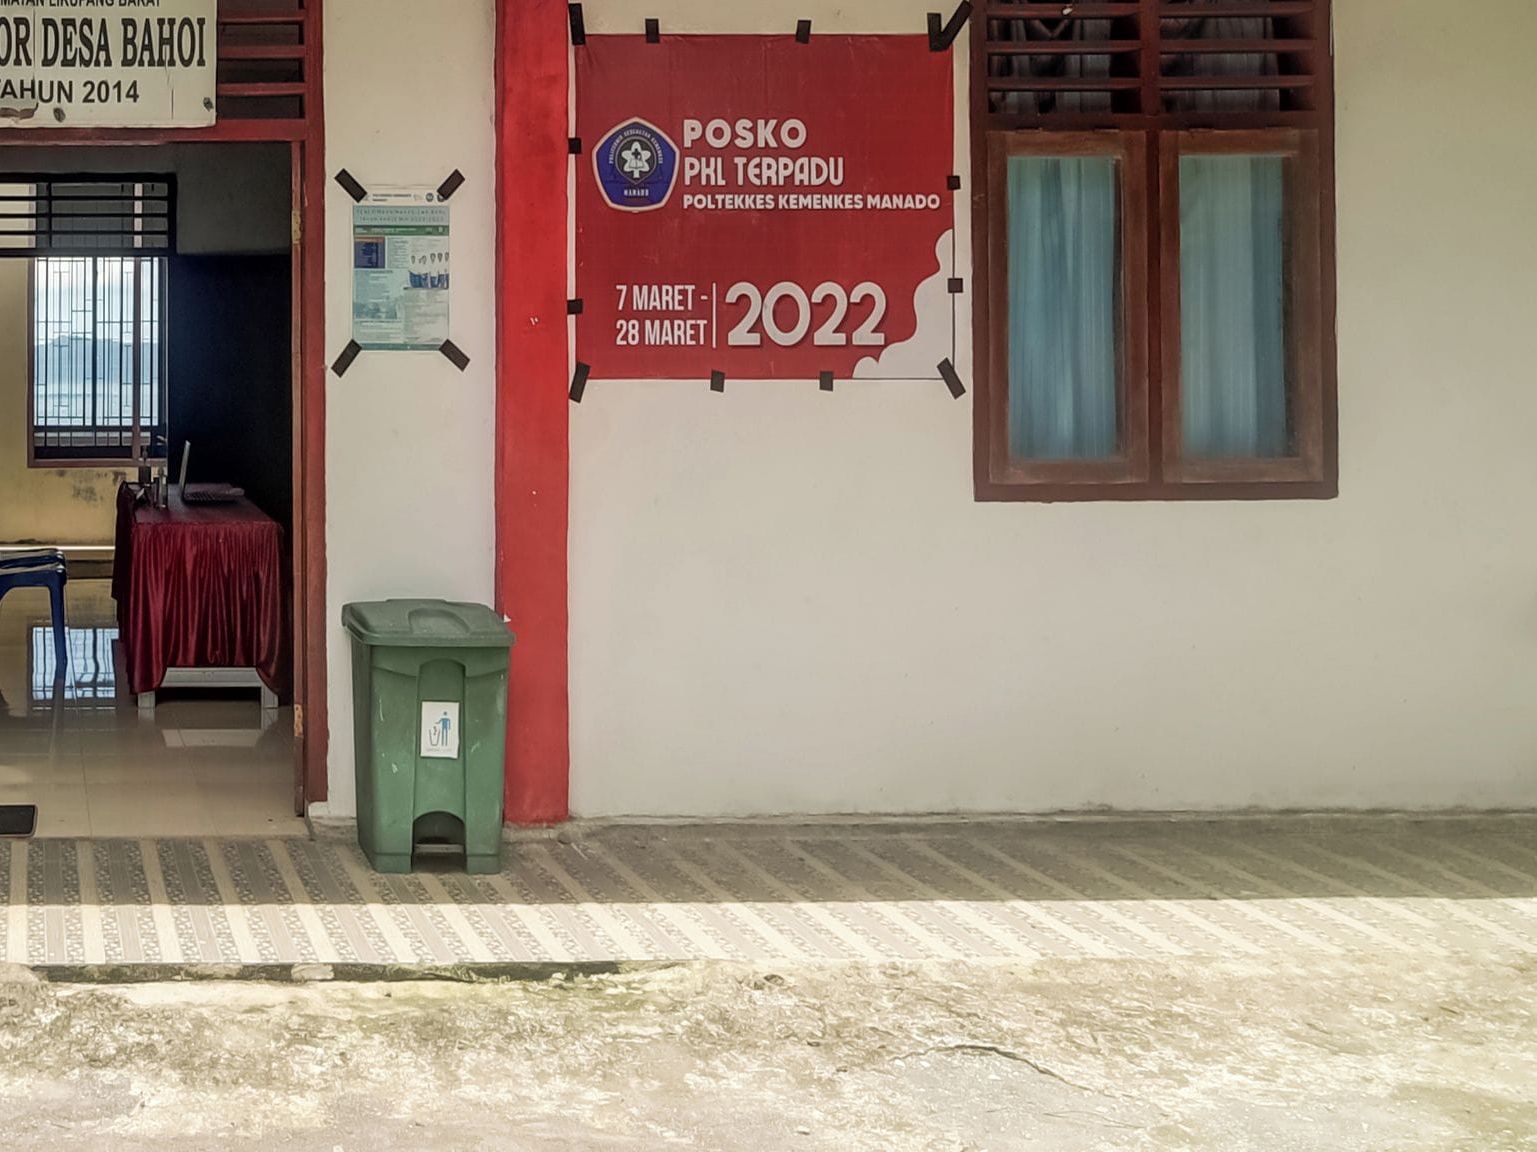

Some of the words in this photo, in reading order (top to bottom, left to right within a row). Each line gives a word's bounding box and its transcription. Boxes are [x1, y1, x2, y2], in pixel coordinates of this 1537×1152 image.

[41, 17, 112, 68] DESA
[121, 17, 206, 68] BAHOI
[82, 80, 139, 104] 2014
[683, 119, 807, 148] POSKO
[684, 157, 726, 186] PKL
[734, 157, 844, 186] TERPADU
[683, 194, 775, 209] POLTEKKES
[778, 194, 863, 209] KEMENKES
[867, 194, 940, 209] MANADO
[616, 284, 627, 311] 7
[632, 285, 695, 311] MARET
[725, 281, 887, 346] 2022
[616, 320, 639, 345] 28
[645, 320, 707, 345] MARET
